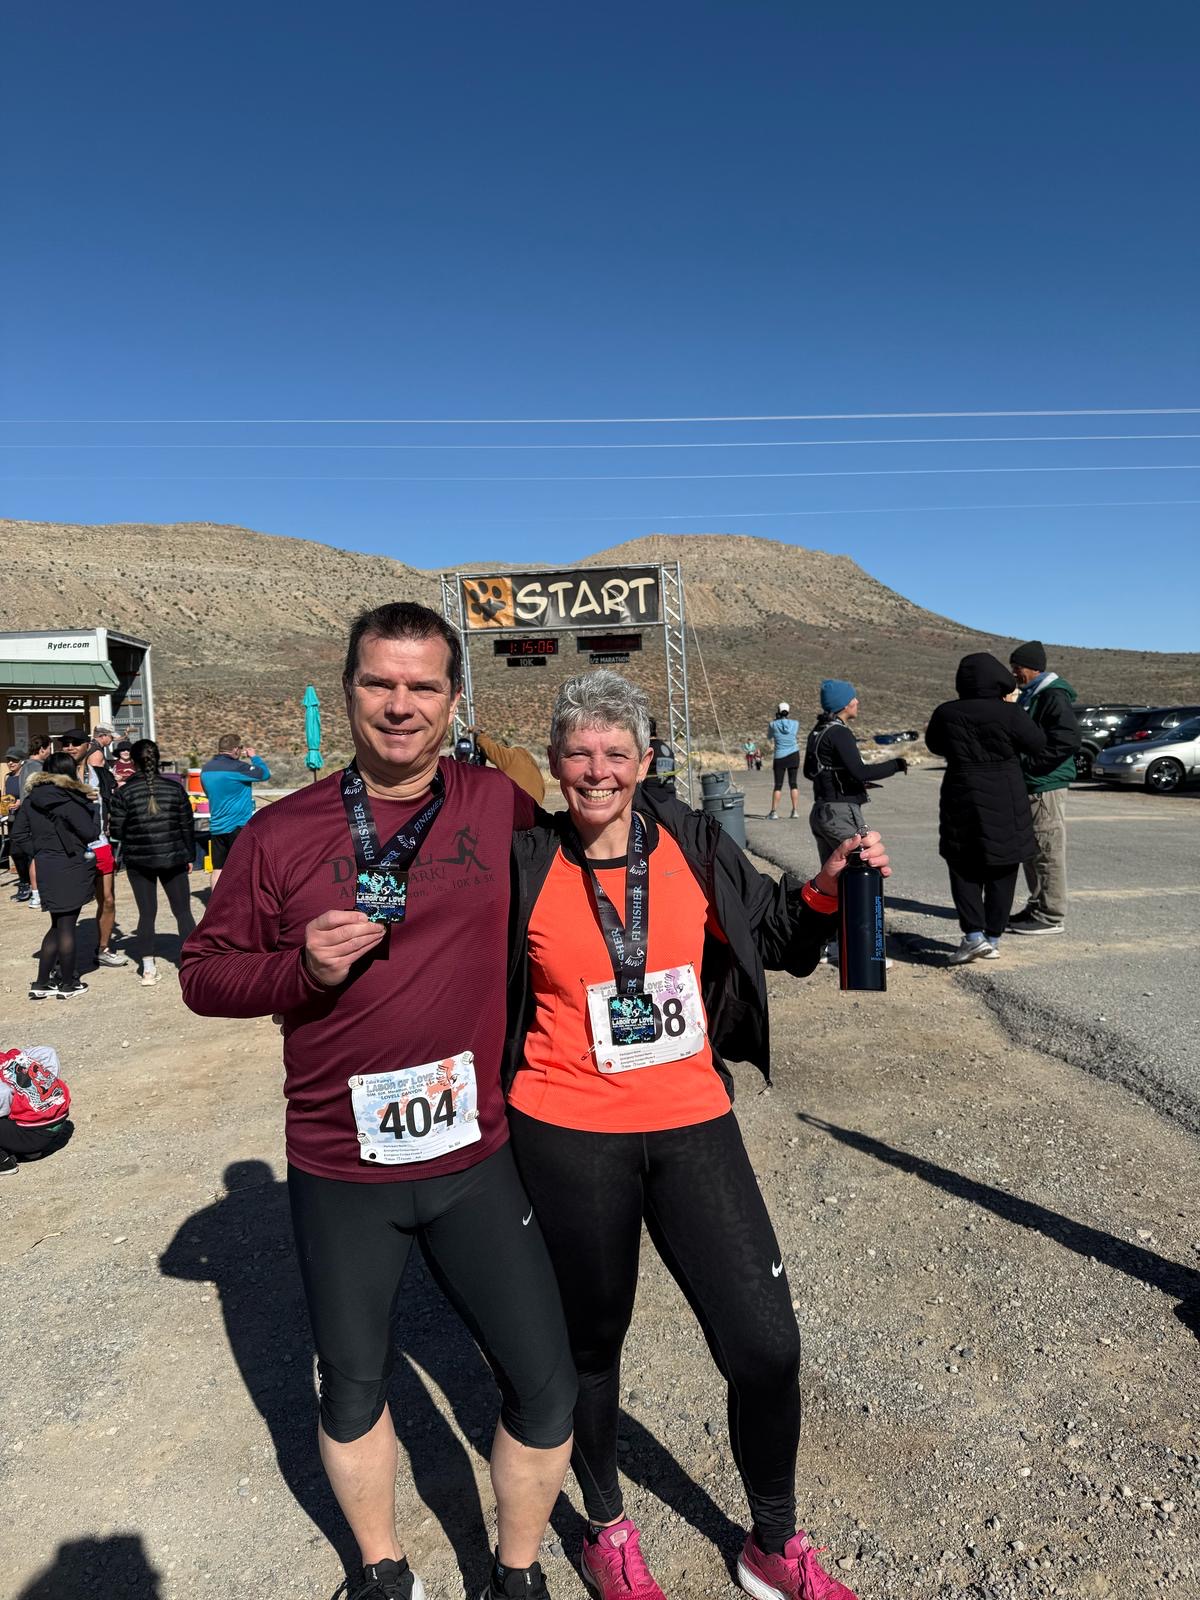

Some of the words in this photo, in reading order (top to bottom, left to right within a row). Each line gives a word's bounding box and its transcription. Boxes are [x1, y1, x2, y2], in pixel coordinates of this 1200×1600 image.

[516, 577, 655, 619] START
[47, 642, 90, 650] Ryder.com
[519, 658, 534, 666] 10K
[353, 802, 375, 861] FINISHER
[413, 797, 445, 833] FINISHER
[632, 885, 642, 941] FINISHER
[367, 1081, 396, 1093] LABOR
[397, 1079, 410, 1088] OF
[411, 1073, 435, 1085] LOVE
[402, 1089, 423, 1097] CANYON
[380, 1088, 456, 1140] 404
